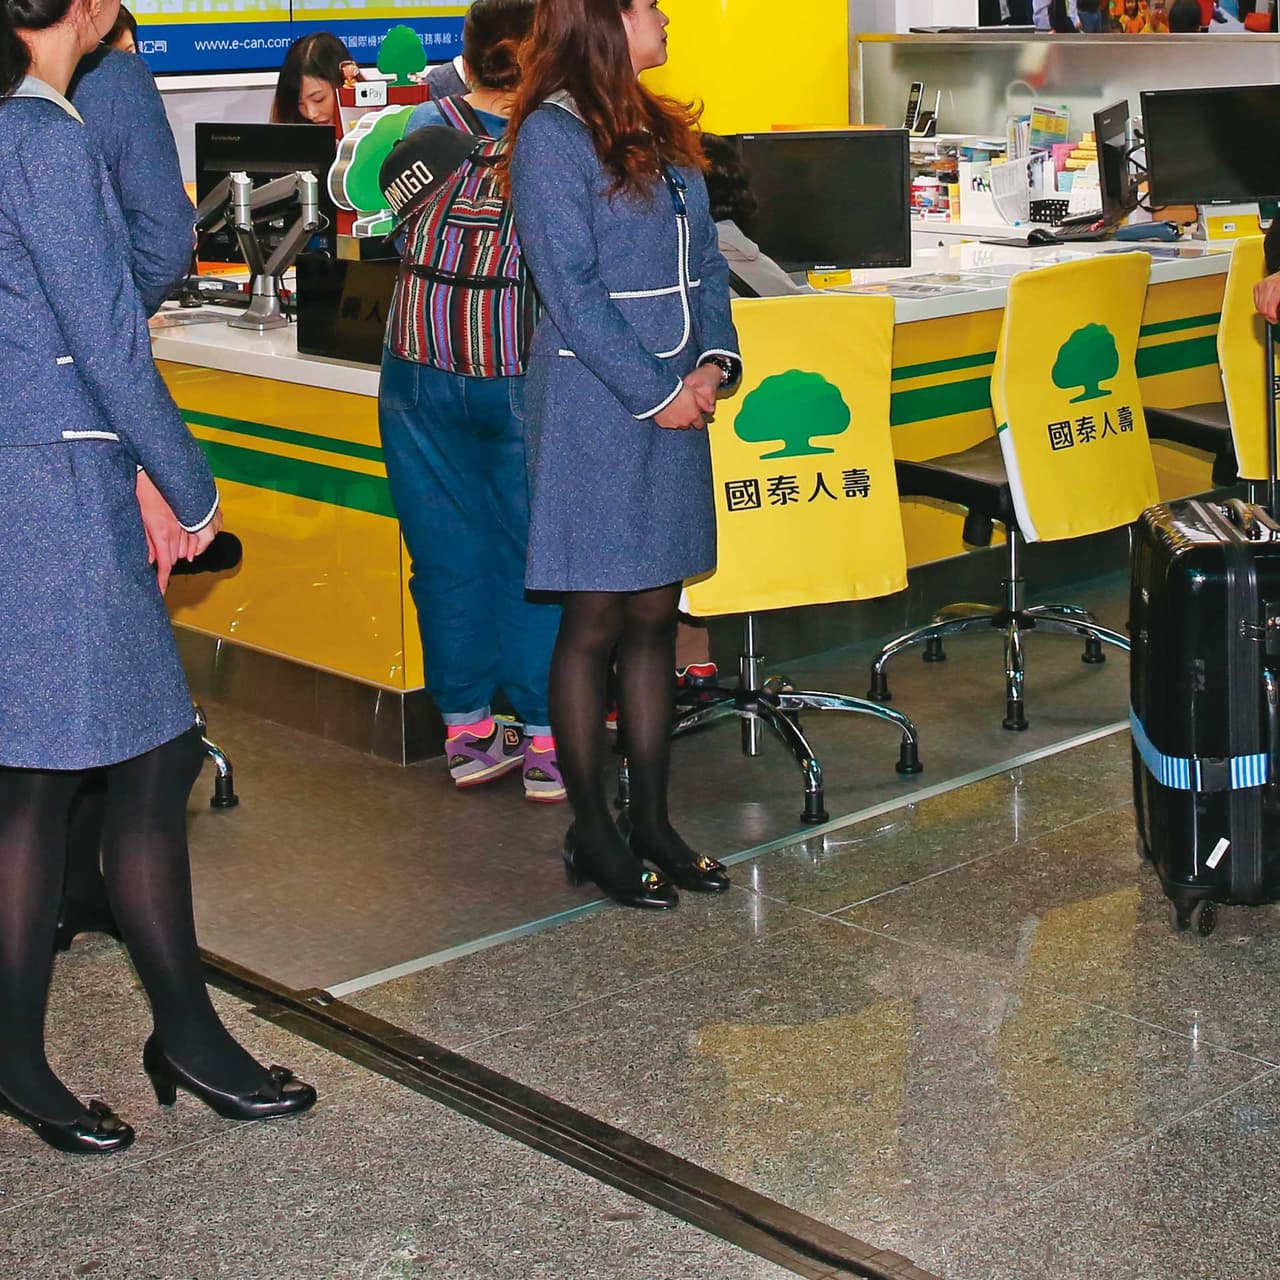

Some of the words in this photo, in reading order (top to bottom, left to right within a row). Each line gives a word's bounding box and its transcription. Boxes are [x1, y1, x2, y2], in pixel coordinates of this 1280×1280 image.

[194, 37, 298, 51] www.e-can.com
[368, 88, 383, 99] Pay
[384, 160, 434, 216] AMIGO
[1047, 406, 1134, 451] 國泰人壽
[724, 468, 871, 512] 國泰人壽
